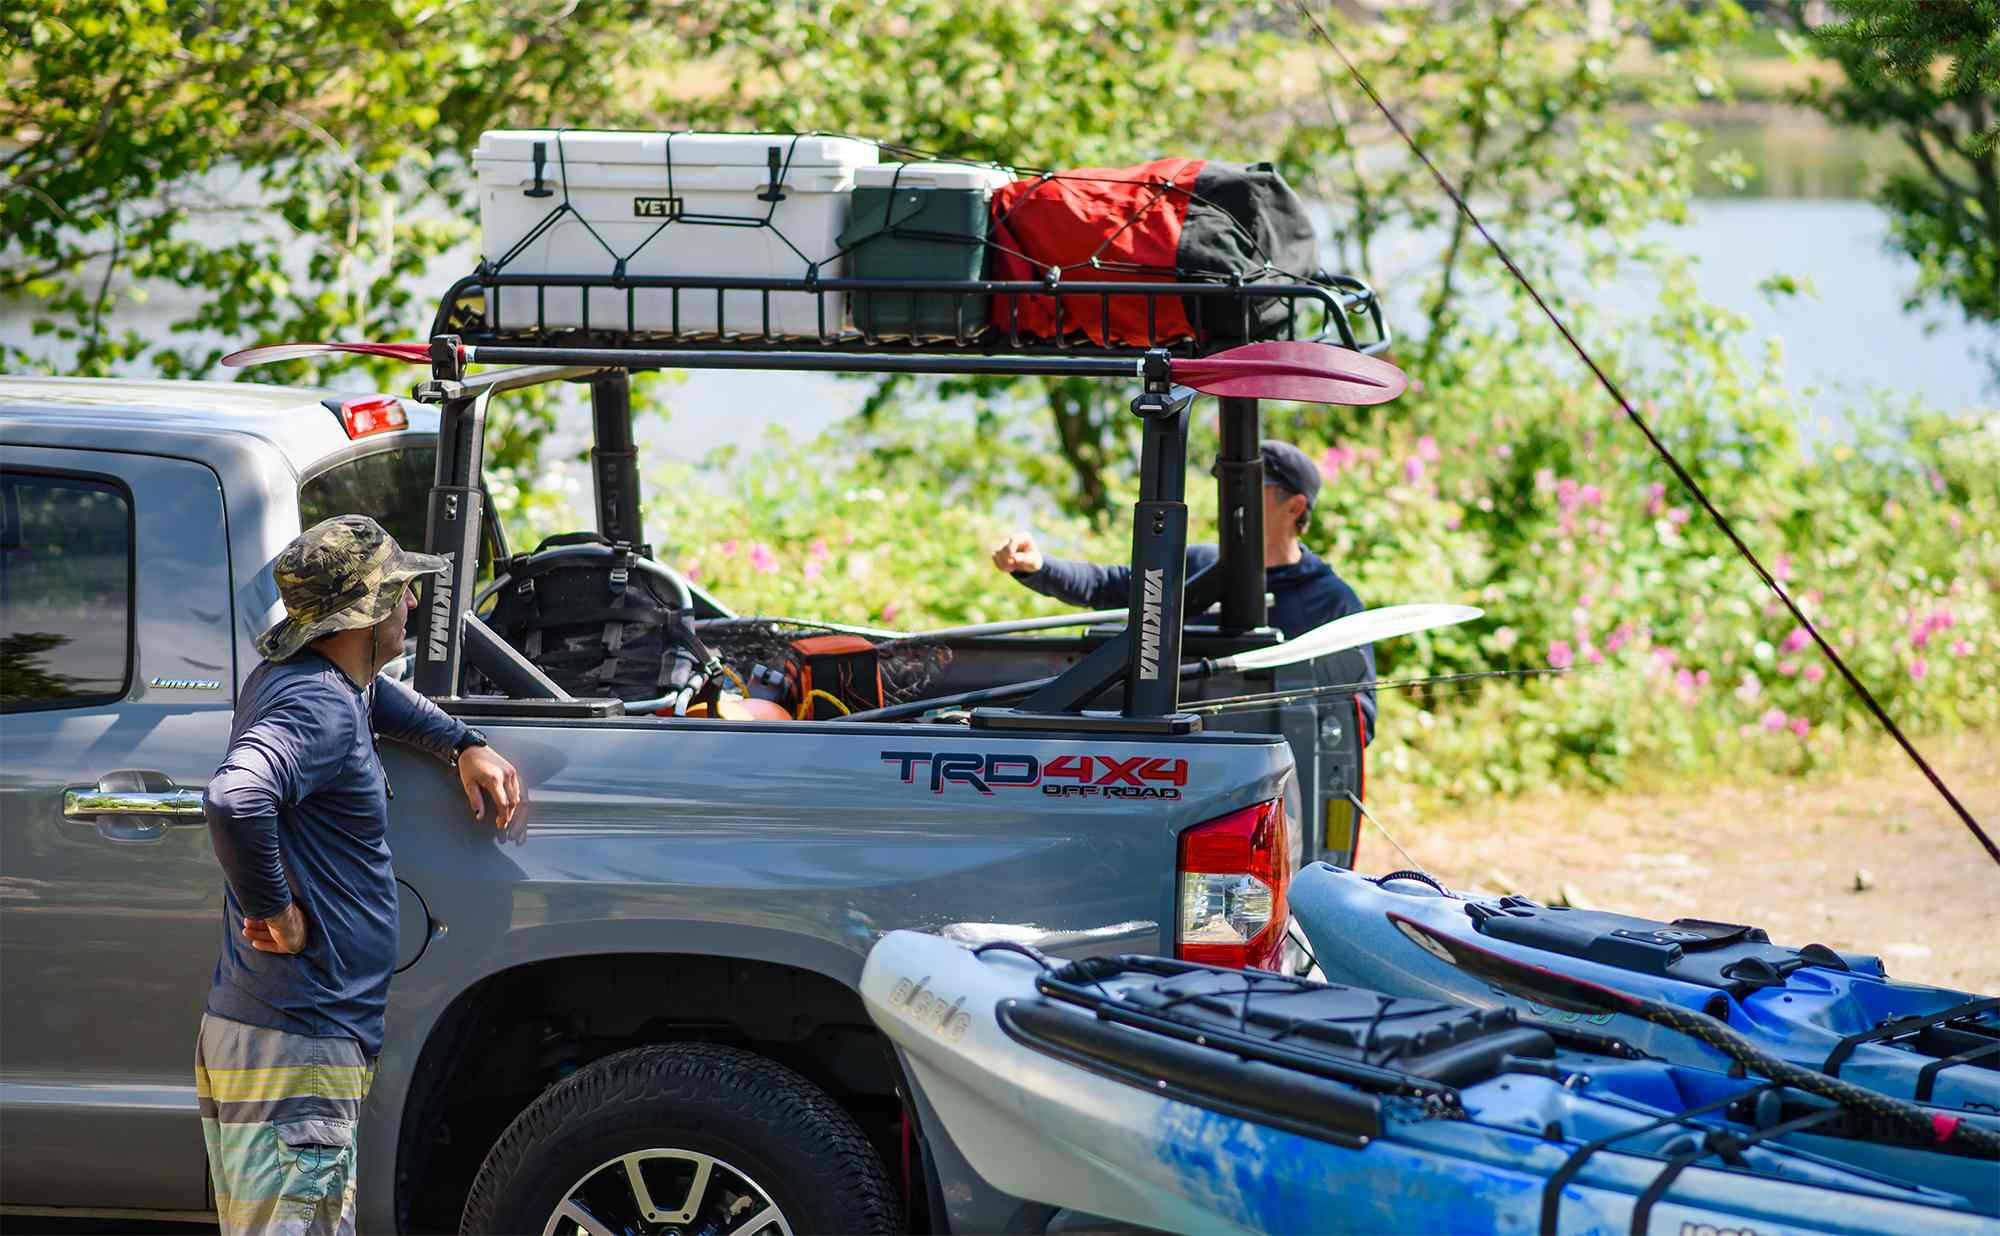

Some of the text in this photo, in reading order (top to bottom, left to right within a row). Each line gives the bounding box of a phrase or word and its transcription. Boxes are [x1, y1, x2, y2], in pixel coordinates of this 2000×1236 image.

[636, 200, 680, 215] YETI
[1140, 568, 1163, 680] YAKIMA
[881, 751, 1041, 796] TRD
[1042, 784, 1184, 801] OFF ROAD
